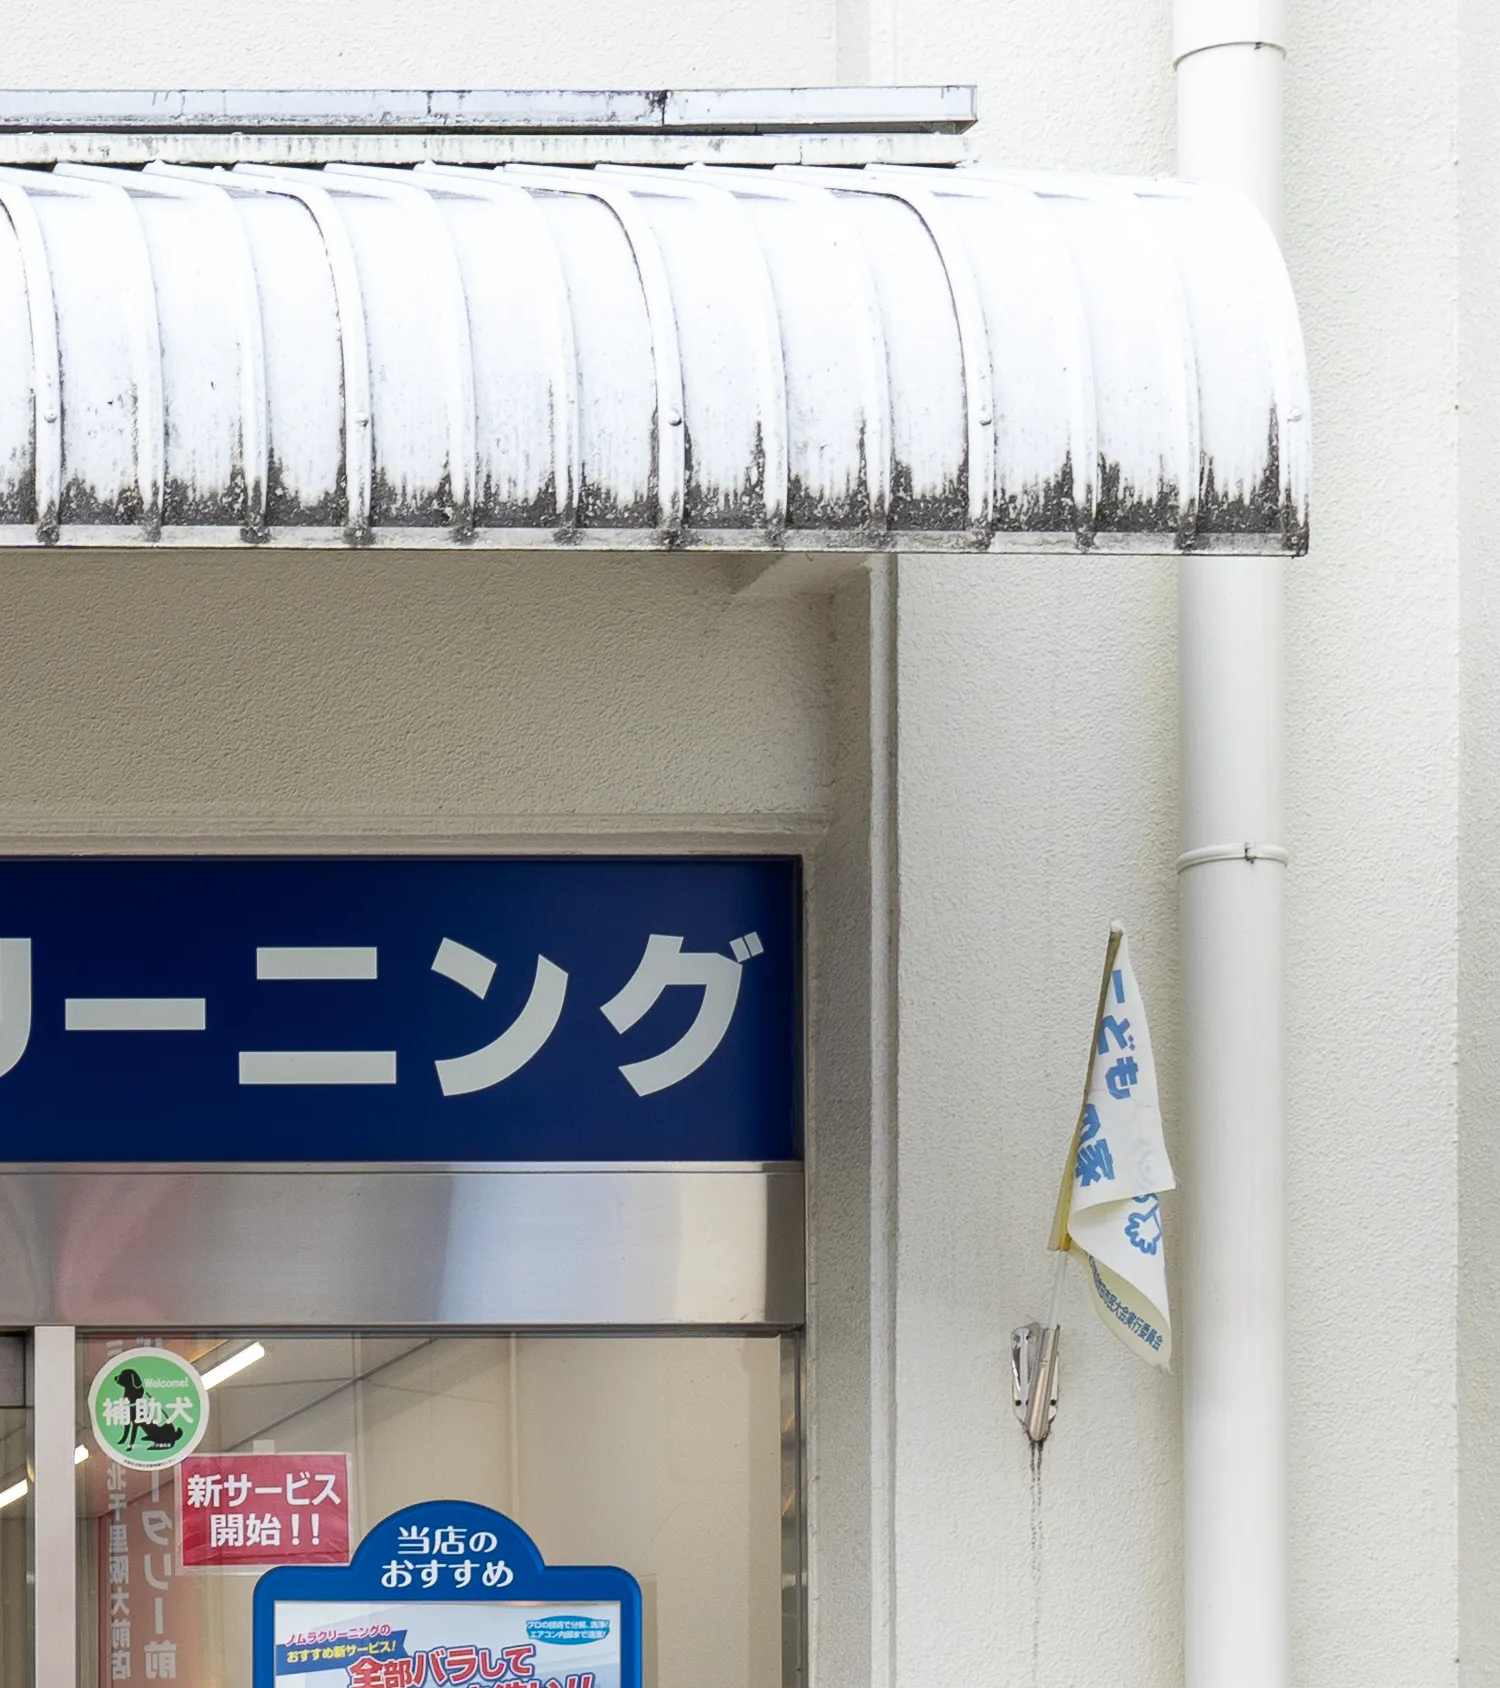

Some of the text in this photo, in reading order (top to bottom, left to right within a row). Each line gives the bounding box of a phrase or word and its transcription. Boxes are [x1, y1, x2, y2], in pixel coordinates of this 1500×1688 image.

[144, 1376, 189, 1389] Welcome!
[102, 1396, 195, 1427] 補助犬
[186, 1473, 341, 1508] 新サービス
[209, 1513, 321, 1548] 開始!!
[396, 1525, 498, 1556] 当店の
[380, 1557, 514, 1589] おすすめ
[285, 1624, 392, 1647] ノムラクリーニングの
[286, 1641, 397, 1664] おすすめ新サービス!
